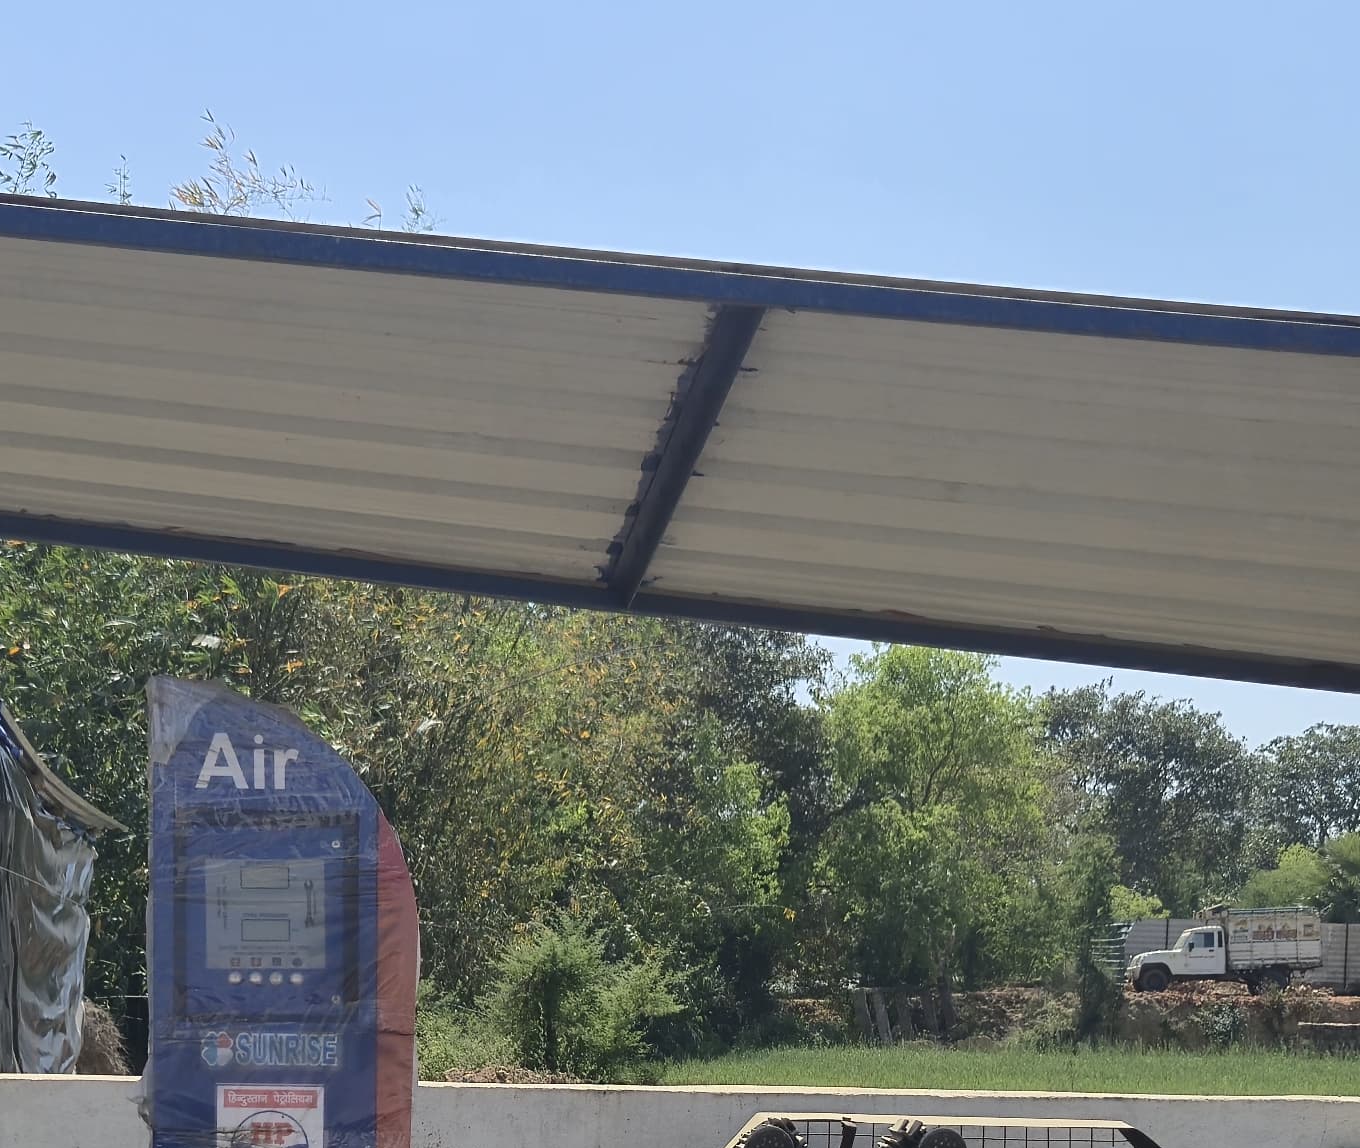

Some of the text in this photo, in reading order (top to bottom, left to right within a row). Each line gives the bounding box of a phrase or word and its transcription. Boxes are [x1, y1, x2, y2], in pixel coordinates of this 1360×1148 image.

[195, 732, 299, 790] Air
[235, 1032, 338, 1066] SUNRISE
[228, 1091, 313, 1106] हिन्दुस्तान पेट्रोलियम
[251, 1122, 293, 1145] HP
